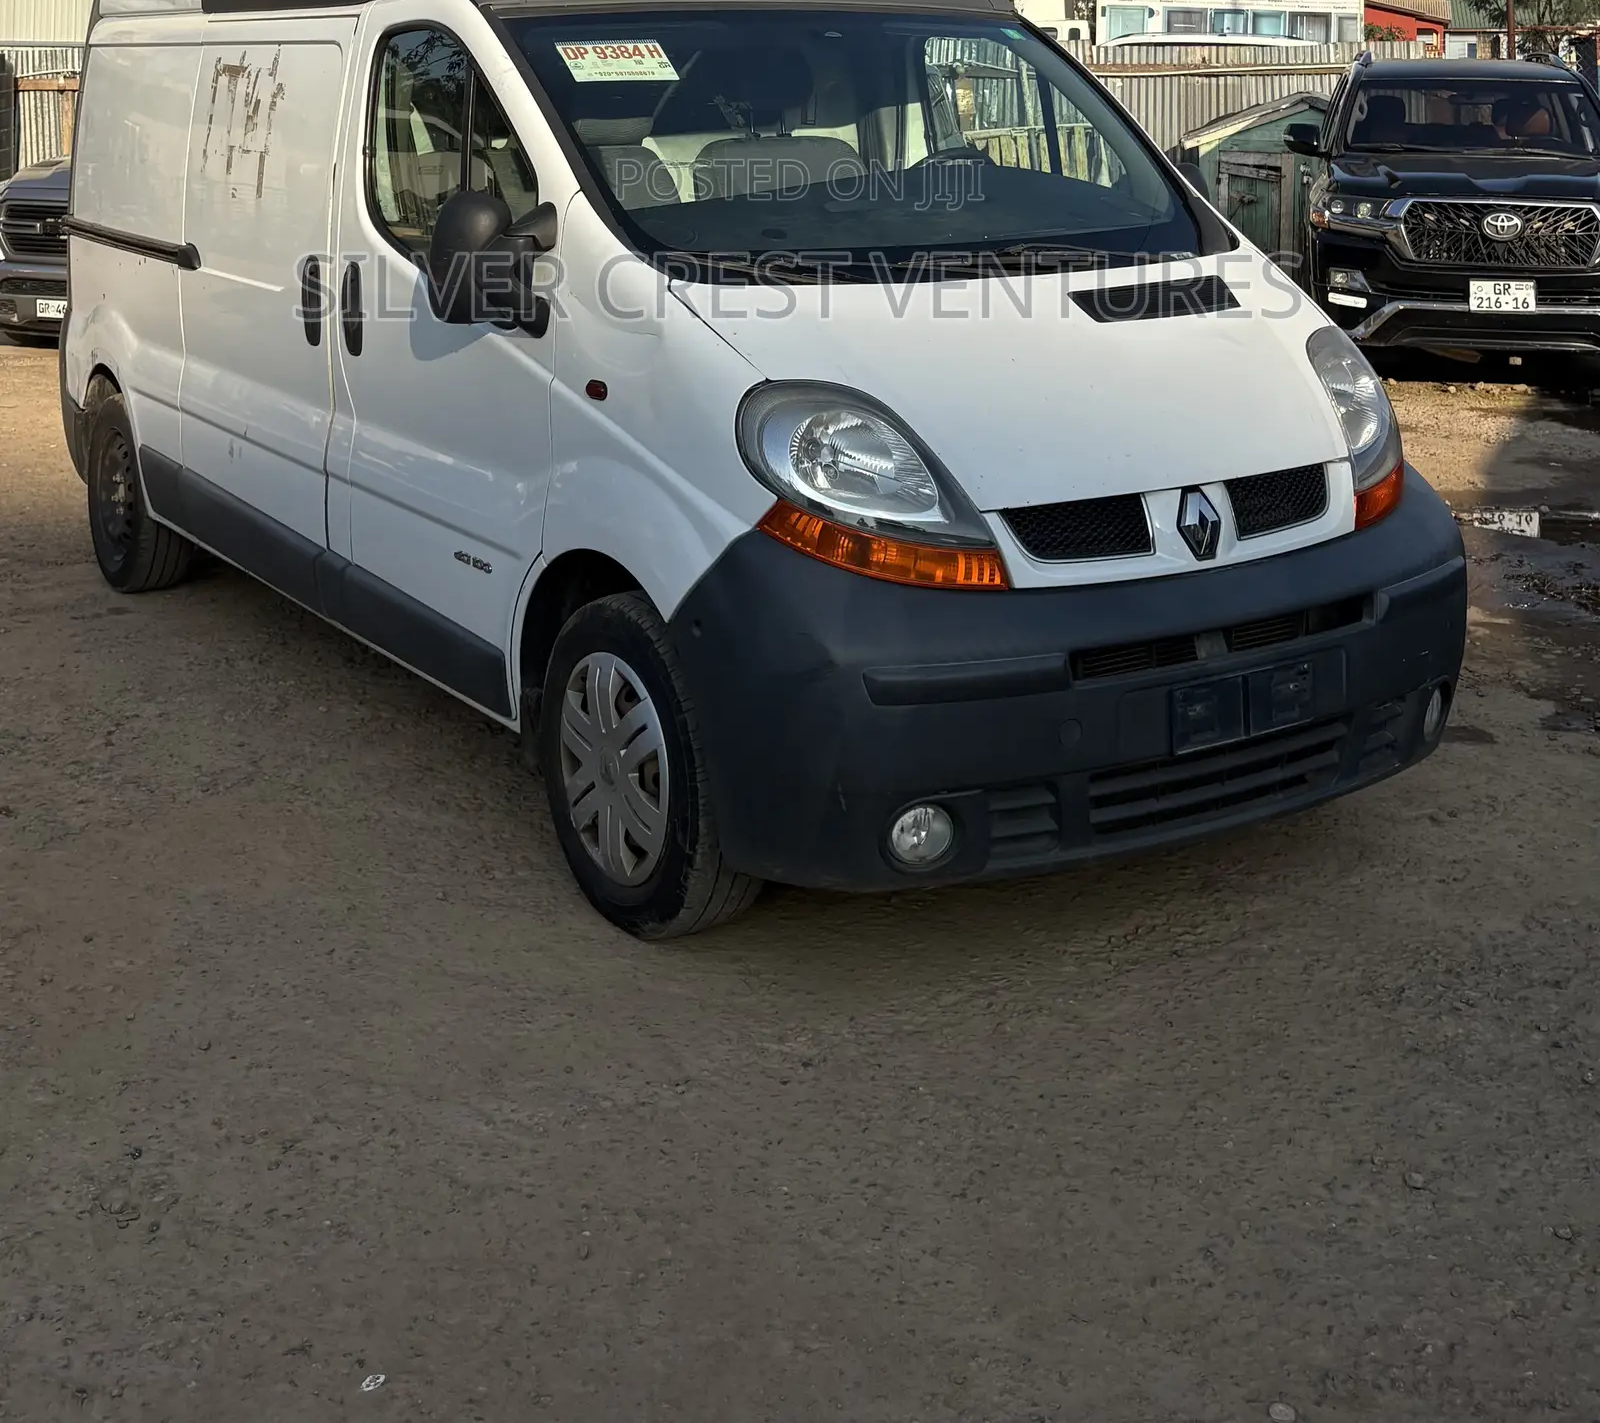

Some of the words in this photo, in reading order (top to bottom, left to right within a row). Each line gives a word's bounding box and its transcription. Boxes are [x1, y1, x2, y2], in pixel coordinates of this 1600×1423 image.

[561, 46, 589, 61] DP
[592, 45, 645, 60] 9384
[644, 44, 663, 59] H
[1493, 283, 1512, 296] GR
[38, 302, 50, 314] GR
[1476, 297, 1530, 309] 216-16
